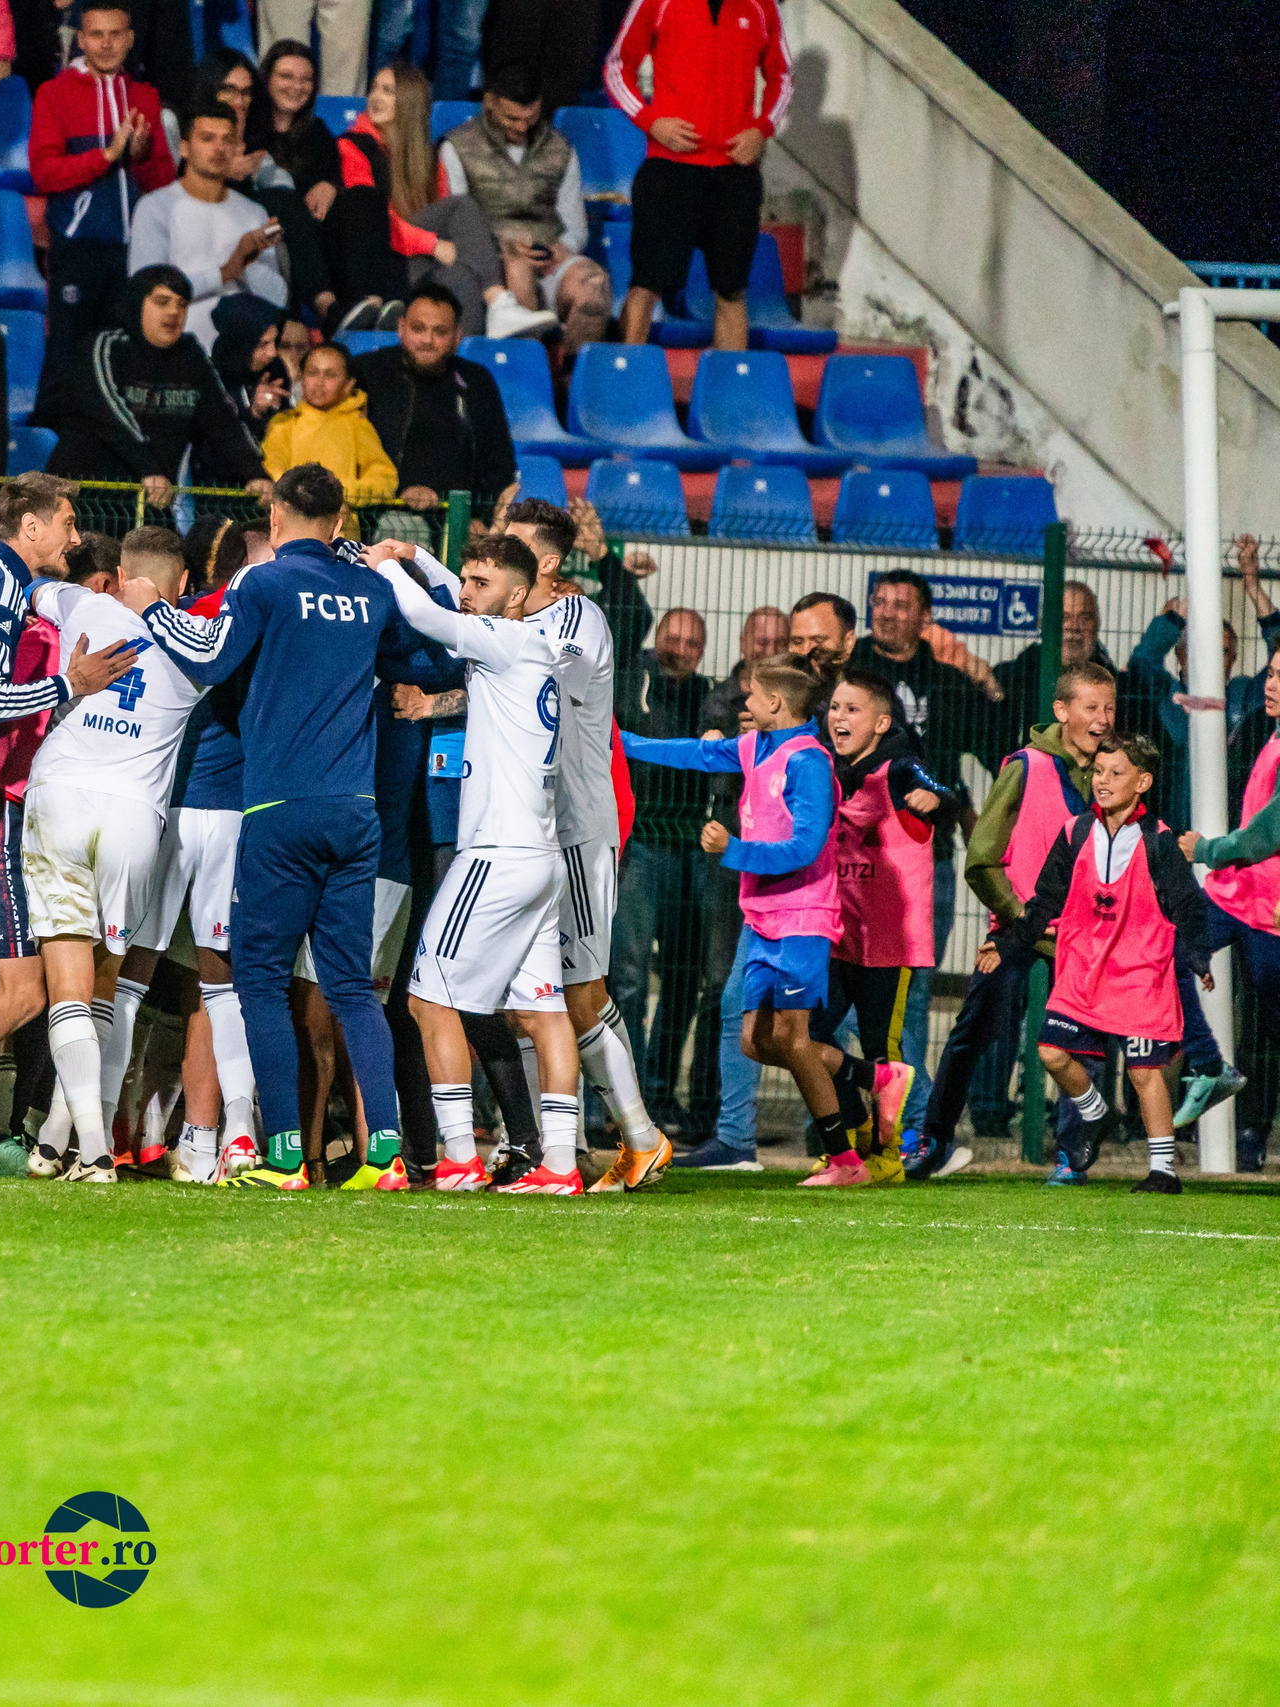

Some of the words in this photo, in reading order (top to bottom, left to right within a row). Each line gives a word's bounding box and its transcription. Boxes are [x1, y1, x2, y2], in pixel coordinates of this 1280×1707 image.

[297, 592, 370, 624] FCBT
[104, 636, 155, 712] 4
[82, 712, 142, 739] MIRON
[536, 676, 561, 765] 9
[1126, 1036, 1154, 1058] 20
